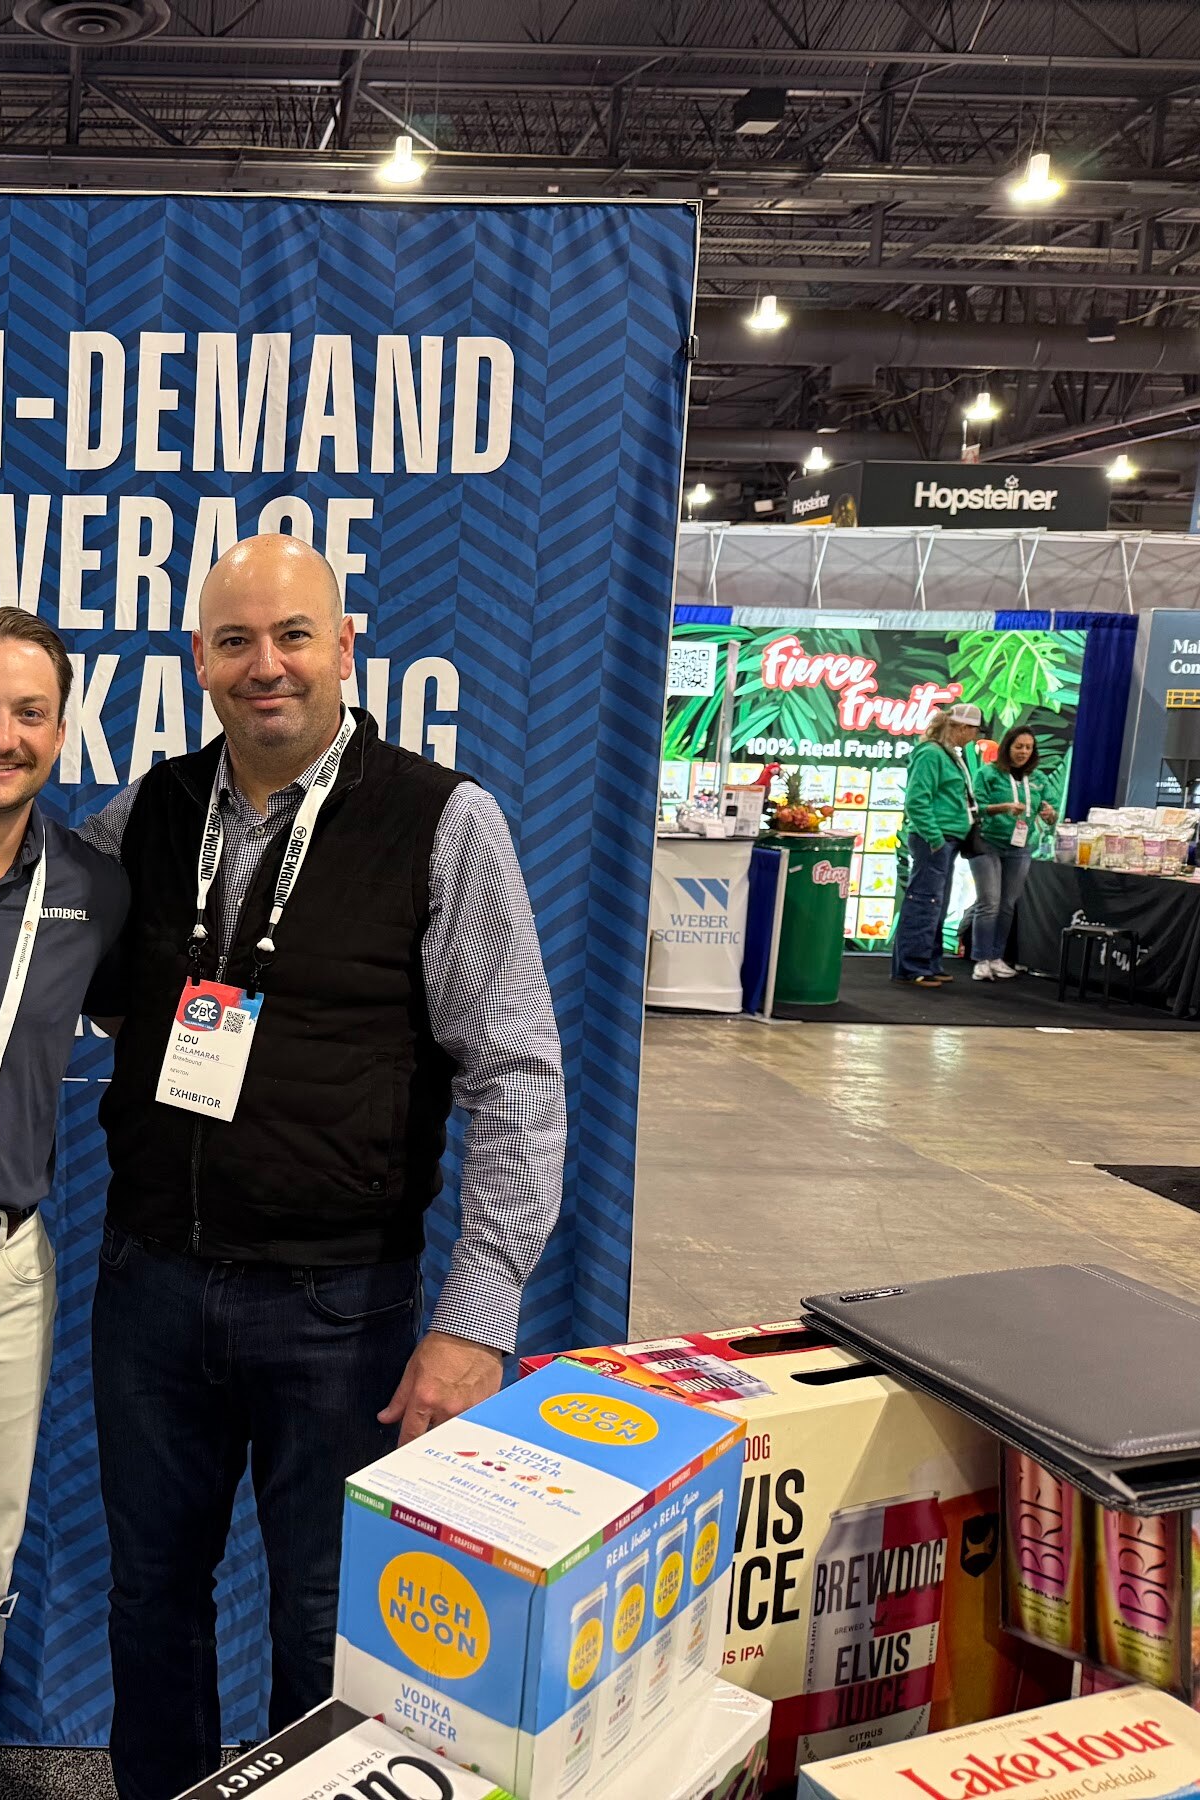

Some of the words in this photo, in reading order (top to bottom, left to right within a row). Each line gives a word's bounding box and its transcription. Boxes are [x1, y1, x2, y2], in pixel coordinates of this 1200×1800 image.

[763, 637, 873, 684] Fierce
[842, 682, 952, 731] Fruit
[746, 737, 795, 755] 100%
[798, 739, 841, 757] Real
[844, 740, 892, 758] Fruit
[670, 914, 728, 928] WEBER
[654, 929, 740, 945] SCIENTIFIC
[187, 1004, 218, 1020] CBC
[177, 1032, 199, 1045] LOU
[172, 1054, 202, 1066] Brewbound
[175, 1044, 220, 1061] CALAMARAS
[169, 1086, 221, 1109] EXHIBITOR
[549, 1404, 638, 1441] NOON
[567, 1400, 642, 1430] HIGH
[495, 1449, 561, 1478] SELTZER
[511, 1445, 562, 1469] VODKA
[425, 1448, 461, 1465] REAL
[509, 1481, 546, 1501] REAL
[449, 1475, 488, 1497] VARIETY
[491, 1492, 520, 1508] PACK
[399, 1511, 417, 1526] BLACK
[417, 1519, 438, 1534] CHERRY
[606, 1546, 629, 1569] REAL
[659, 1503, 680, 1526] REAL
[697, 1538, 715, 1558] HIGH
[659, 1567, 680, 1588] HIGH
[813, 1539, 943, 1616] BREWDOG
[398, 1576, 471, 1629] HIGH
[619, 1600, 641, 1624] HIGH
[389, 1598, 476, 1658] NOON
[834, 1623, 865, 1635] BREWED
[574, 1635, 598, 1659] HIGH
[740, 1644, 764, 1662] IPA
[808, 1621, 817, 1664] UNITED
[834, 1632, 911, 1686] ELVIS
[807, 1667, 814, 1686] WE
[401, 1683, 451, 1722] VODKA
[828, 1674, 909, 1727] JUICE
[394, 1698, 457, 1742] SELTZER
[849, 1727, 883, 1743] CITRUS
[857, 1740, 872, 1750] IPA
[349, 1755, 374, 1776] PACK
[371, 1749, 385, 1761] 12
[895, 1753, 1056, 1800] Lake
[1022, 1719, 1175, 1773] Hour
[216, 1752, 285, 1798] CINCY
[323, 1779, 340, 1792] 110
[1081, 1764, 1156, 1798] Cocktails
